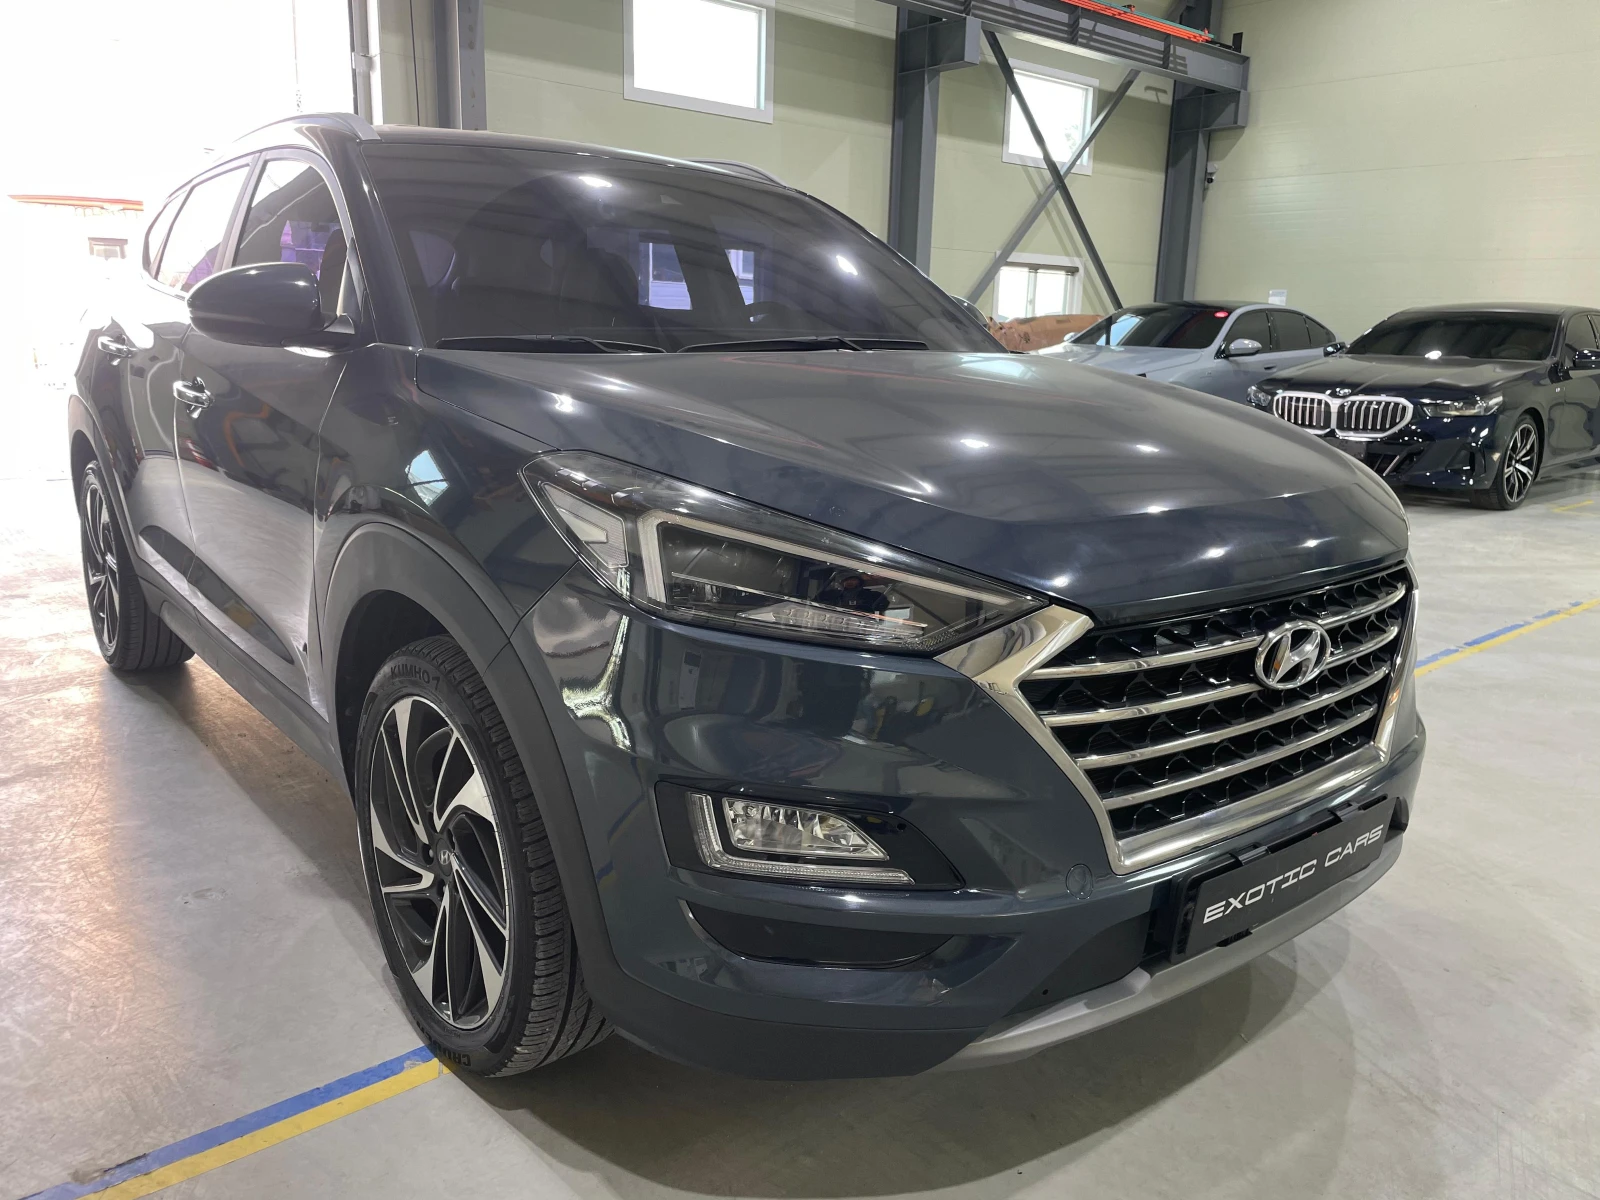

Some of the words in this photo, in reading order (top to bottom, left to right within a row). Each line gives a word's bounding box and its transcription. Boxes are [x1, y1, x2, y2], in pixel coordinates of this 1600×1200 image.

[390, 663, 430, 684] KUMHO
[1203, 859, 1317, 924] EXOTIC
[1324, 824, 1384, 868] CARS
